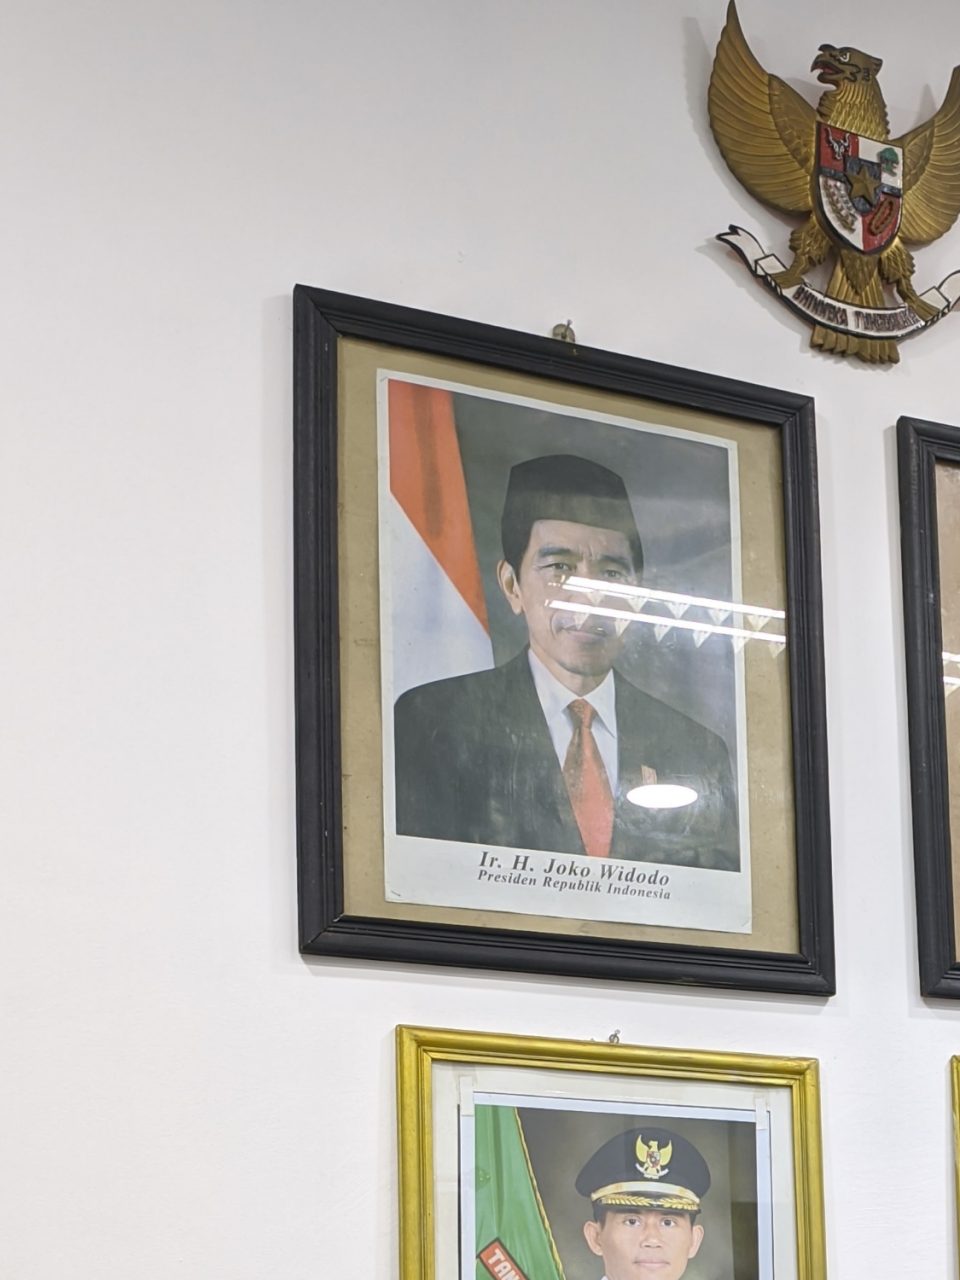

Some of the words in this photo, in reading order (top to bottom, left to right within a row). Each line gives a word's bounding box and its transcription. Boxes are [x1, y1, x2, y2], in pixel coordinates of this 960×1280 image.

[479, 851, 501, 868] Ir.
[512, 854, 534, 872] H.
[544, 858, 591, 878] Joko
[600, 863, 670, 886] Widodo
[478, 870, 537, 887] Presiden
[543, 876, 602, 893] Republik
[607, 883, 671, 900] Indonesia
